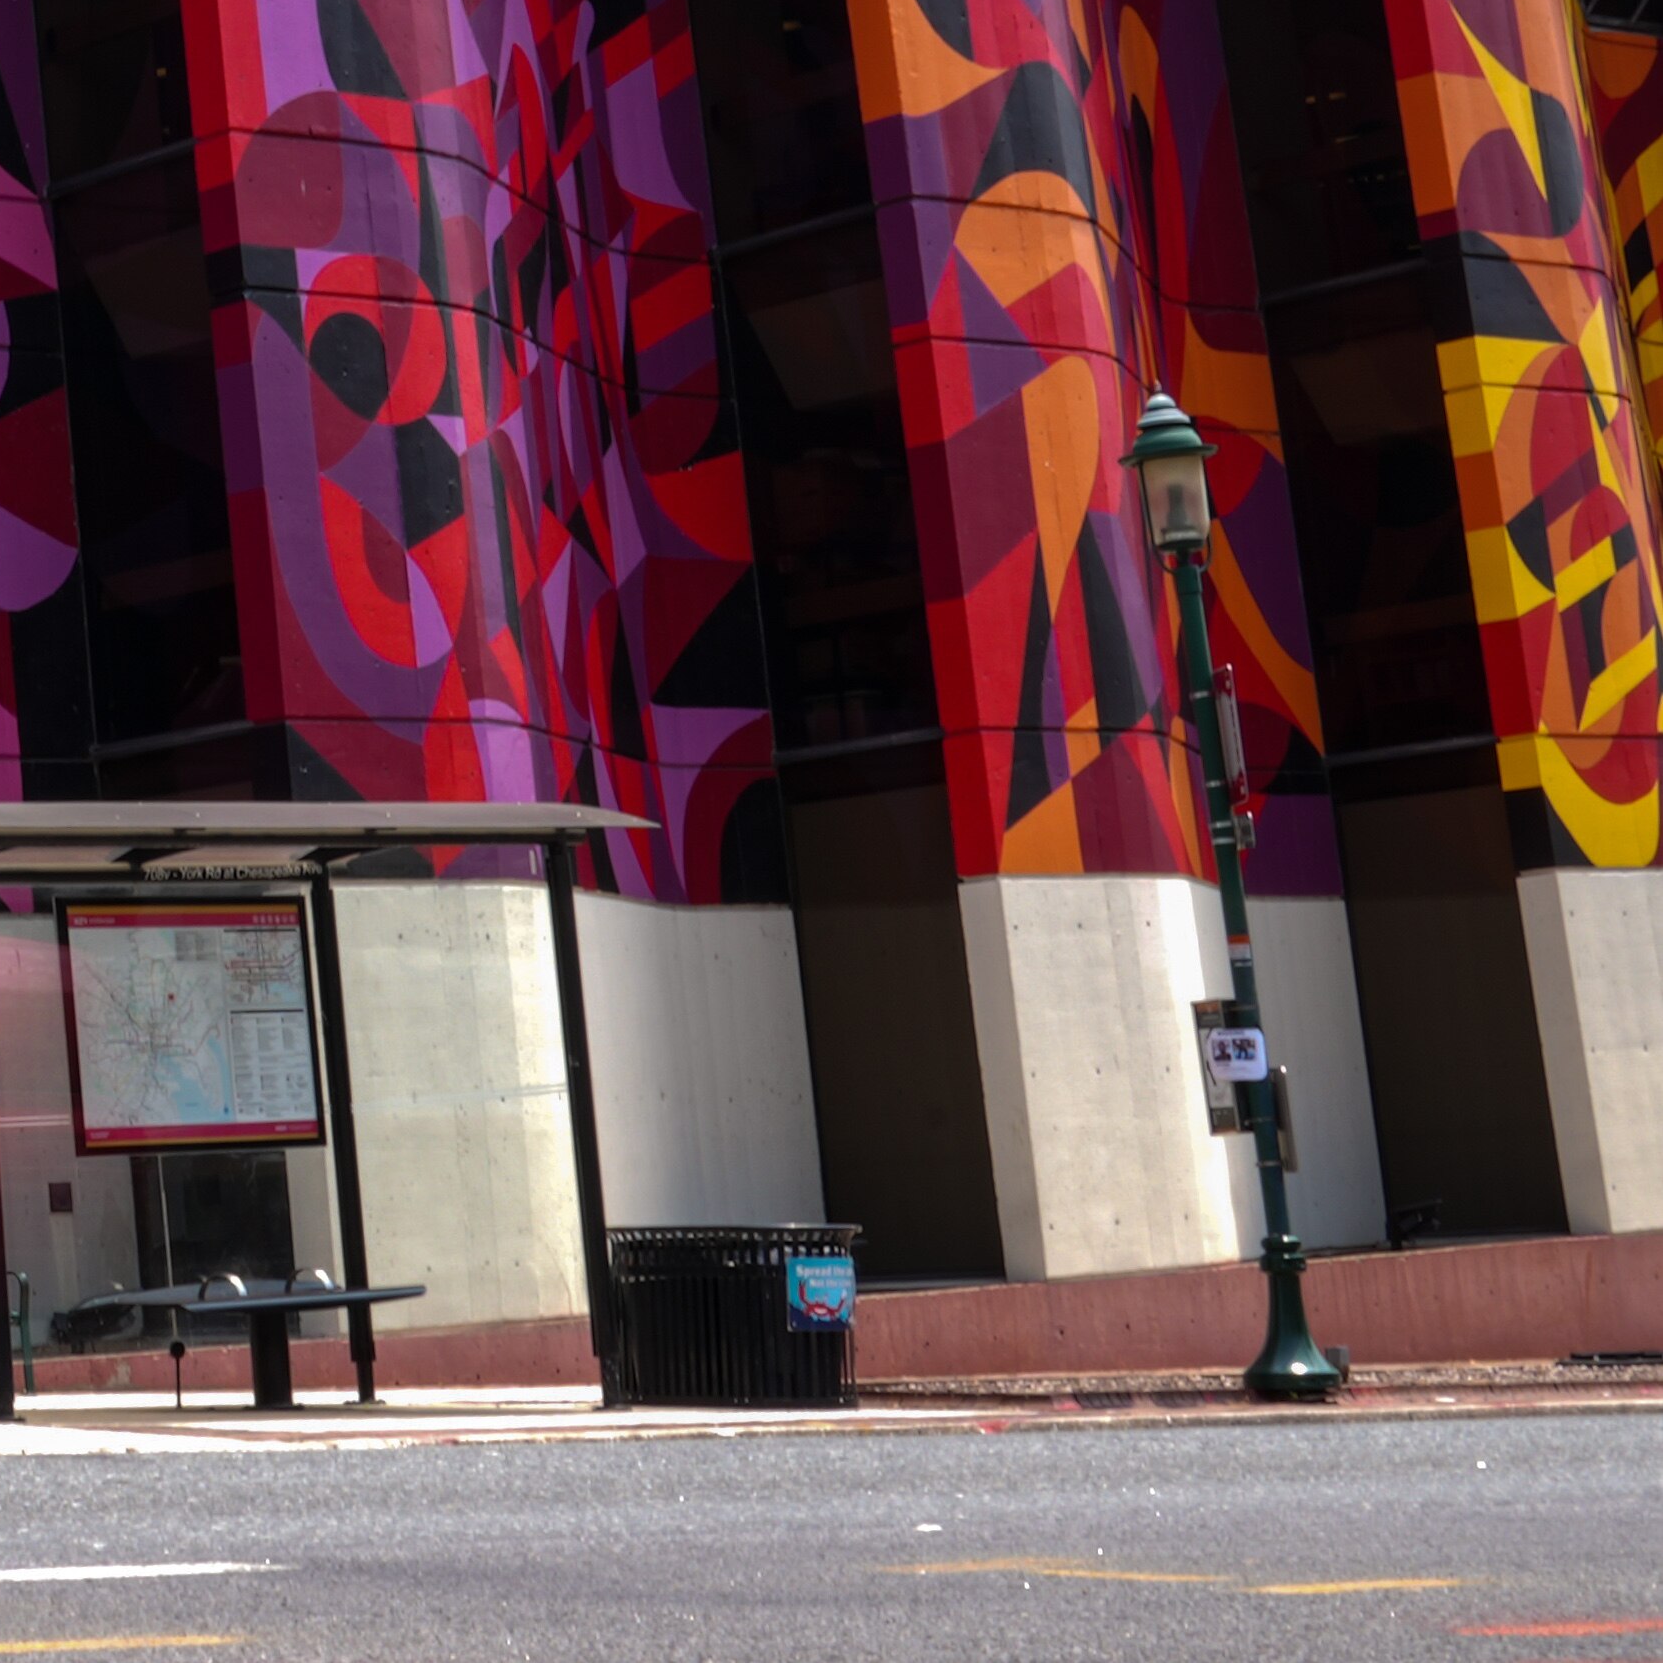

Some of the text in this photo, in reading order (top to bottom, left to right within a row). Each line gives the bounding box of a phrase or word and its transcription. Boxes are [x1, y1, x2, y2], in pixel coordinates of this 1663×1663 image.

[179, 866, 204, 880] York
[205, 866, 222, 880] Rd
[223, 866, 235, 880] at
